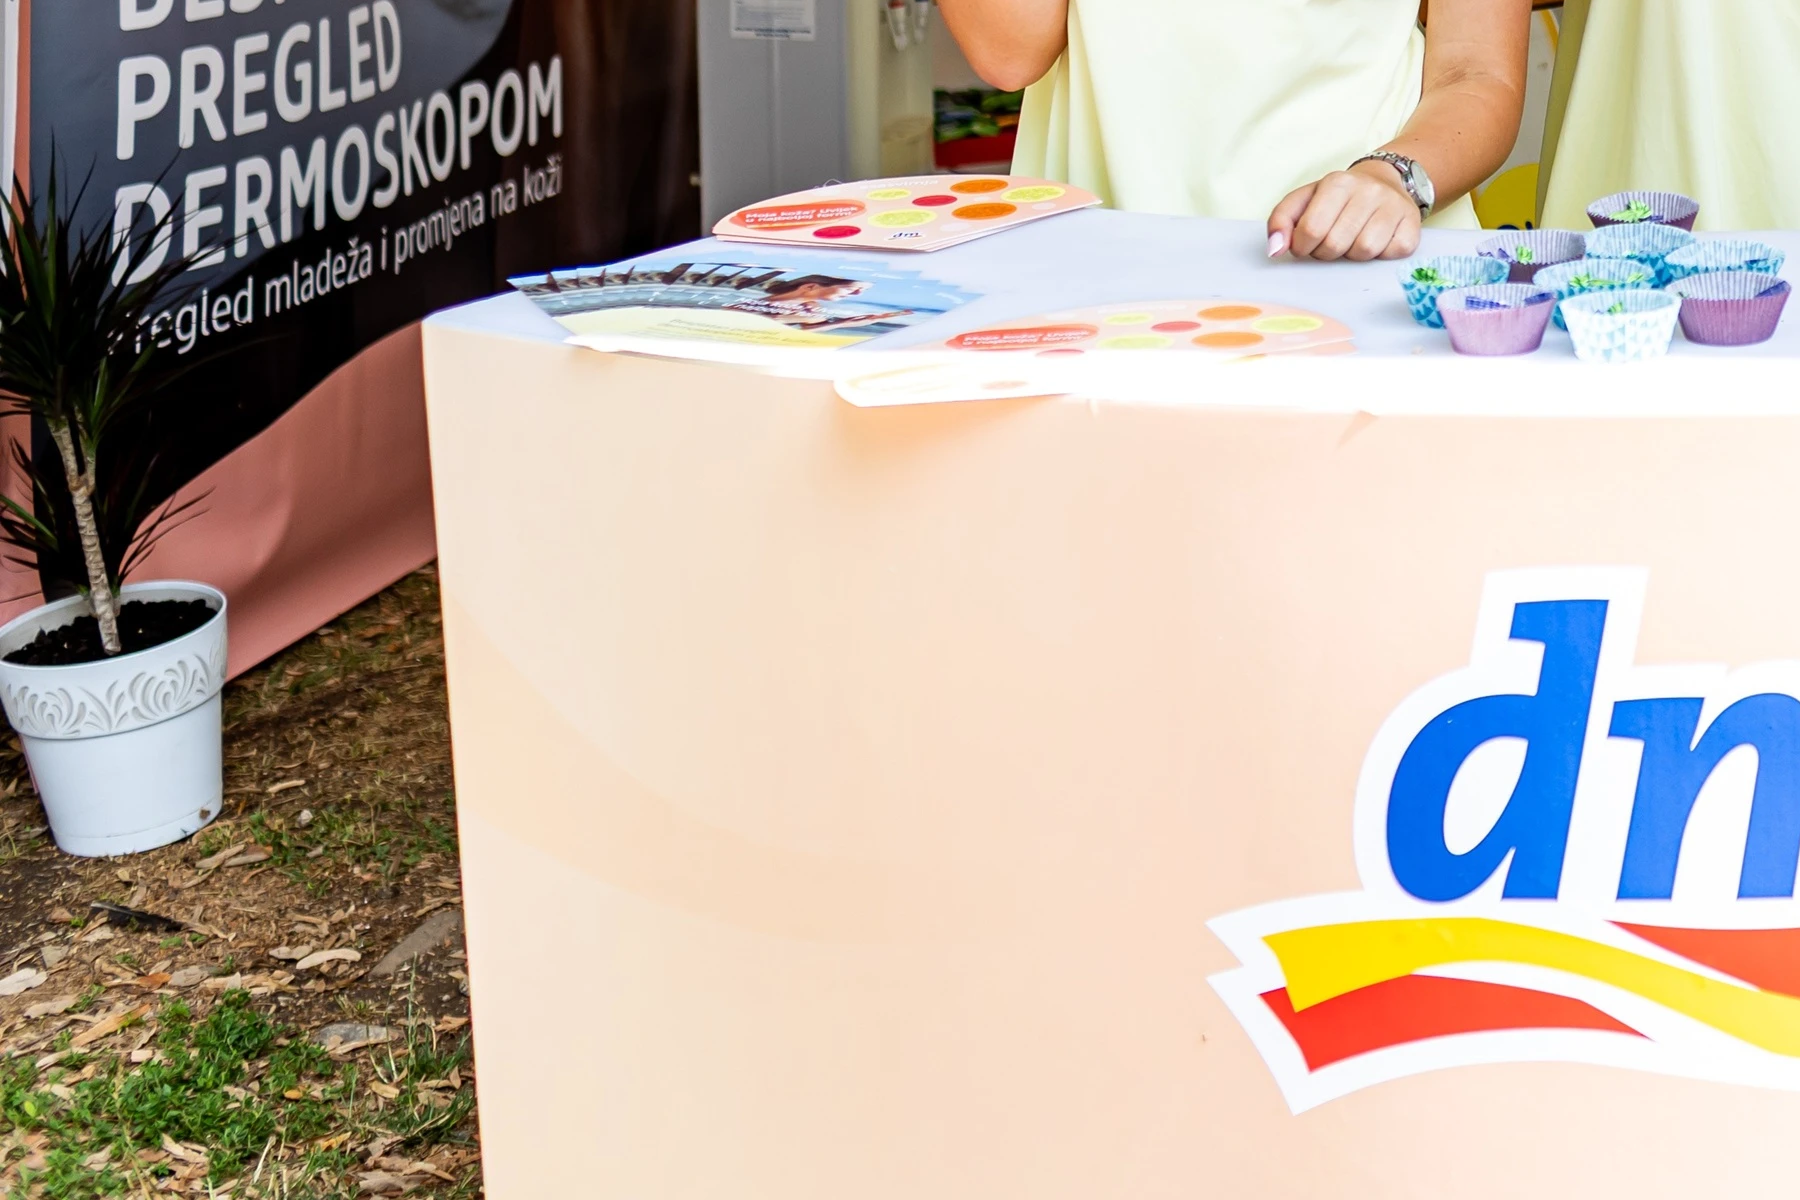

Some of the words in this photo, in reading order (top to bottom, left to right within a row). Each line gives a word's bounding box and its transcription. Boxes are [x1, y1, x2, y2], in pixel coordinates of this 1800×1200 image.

[111, 54, 564, 288] DERMOSKOPOM
[265, 235, 373, 318] mladeža
[380, 226, 388, 271] i
[394, 190, 485, 275] promjena
[491, 176, 517, 219] na
[523, 152, 564, 207] koži
